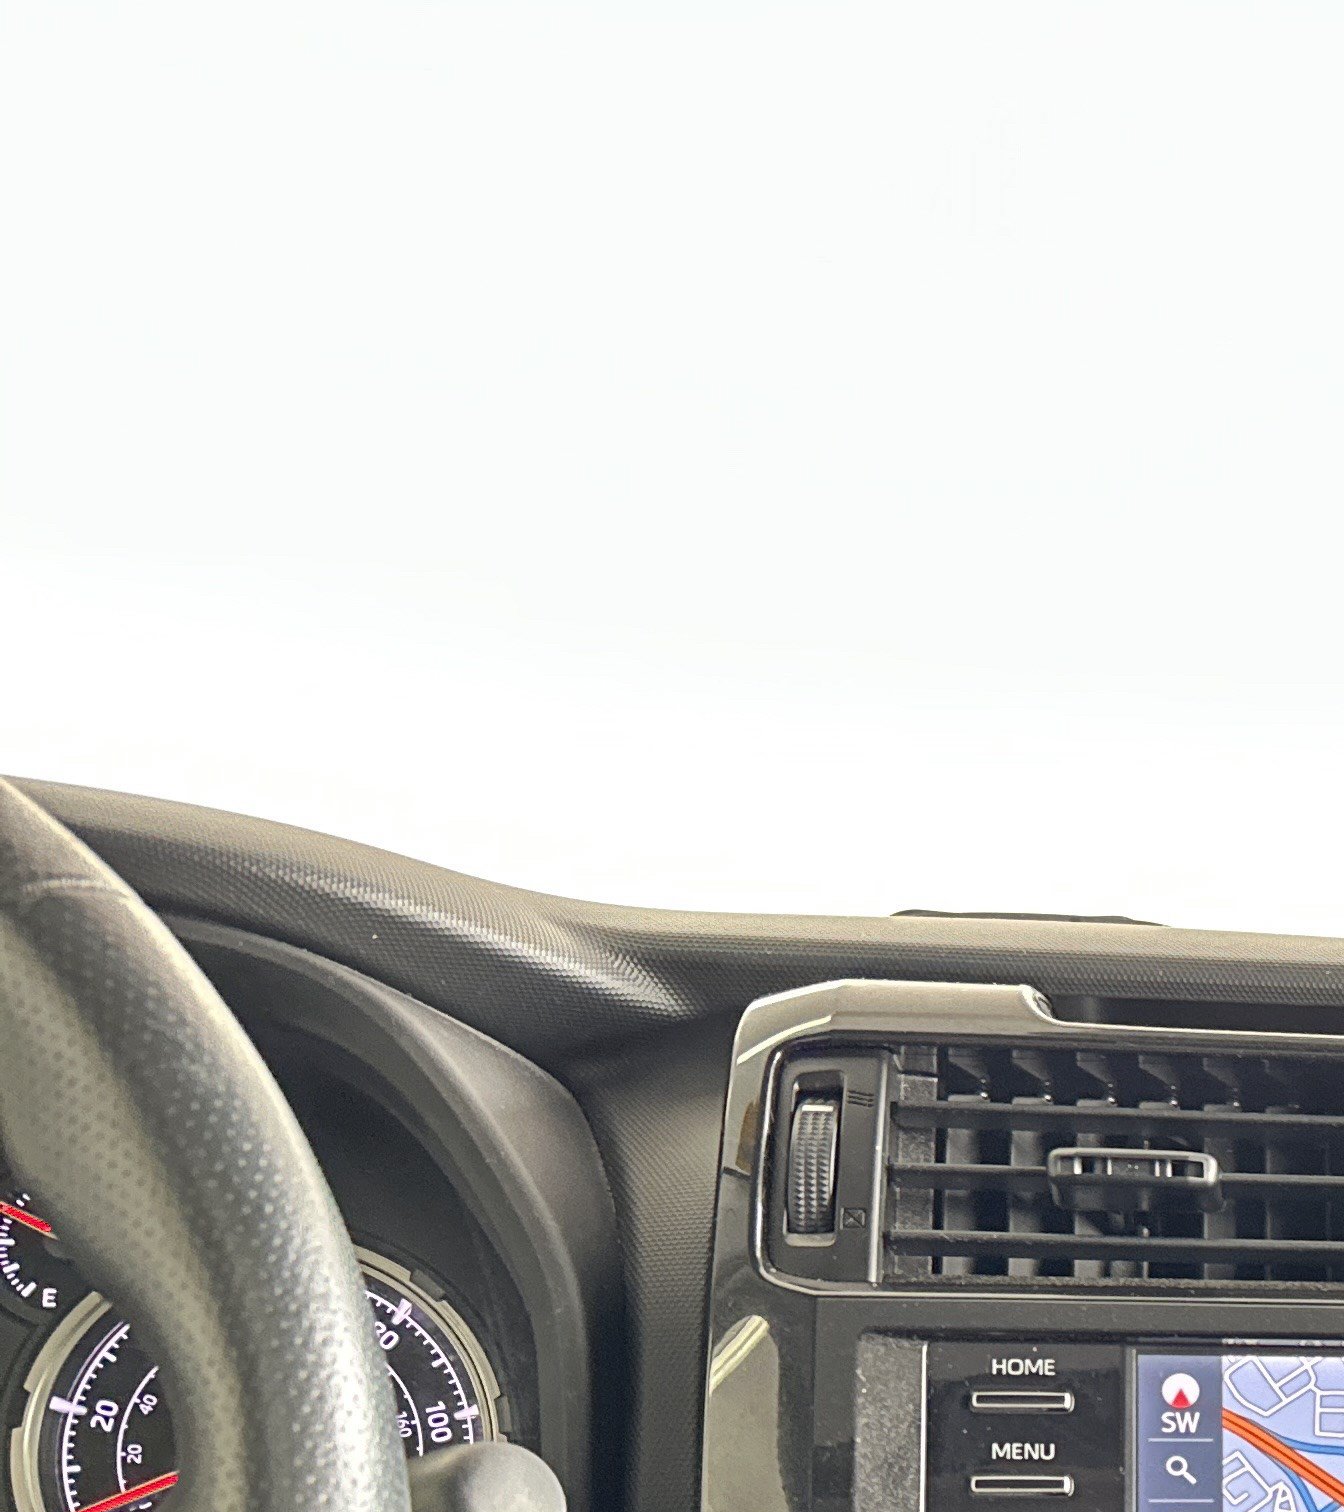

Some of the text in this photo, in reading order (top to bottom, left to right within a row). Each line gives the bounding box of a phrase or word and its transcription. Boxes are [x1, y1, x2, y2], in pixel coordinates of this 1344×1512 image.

[42, 1287, 58, 1308] E
[990, 1358, 1056, 1377] HOME
[138, 1394, 158, 1416] 40
[90, 1399, 119, 1433] 20
[425, 1400, 453, 1443] 100
[1160, 1411, 1200, 1434] SW
[126, 1443, 143, 1464] 20
[990, 1442, 1056, 1461] MENU
